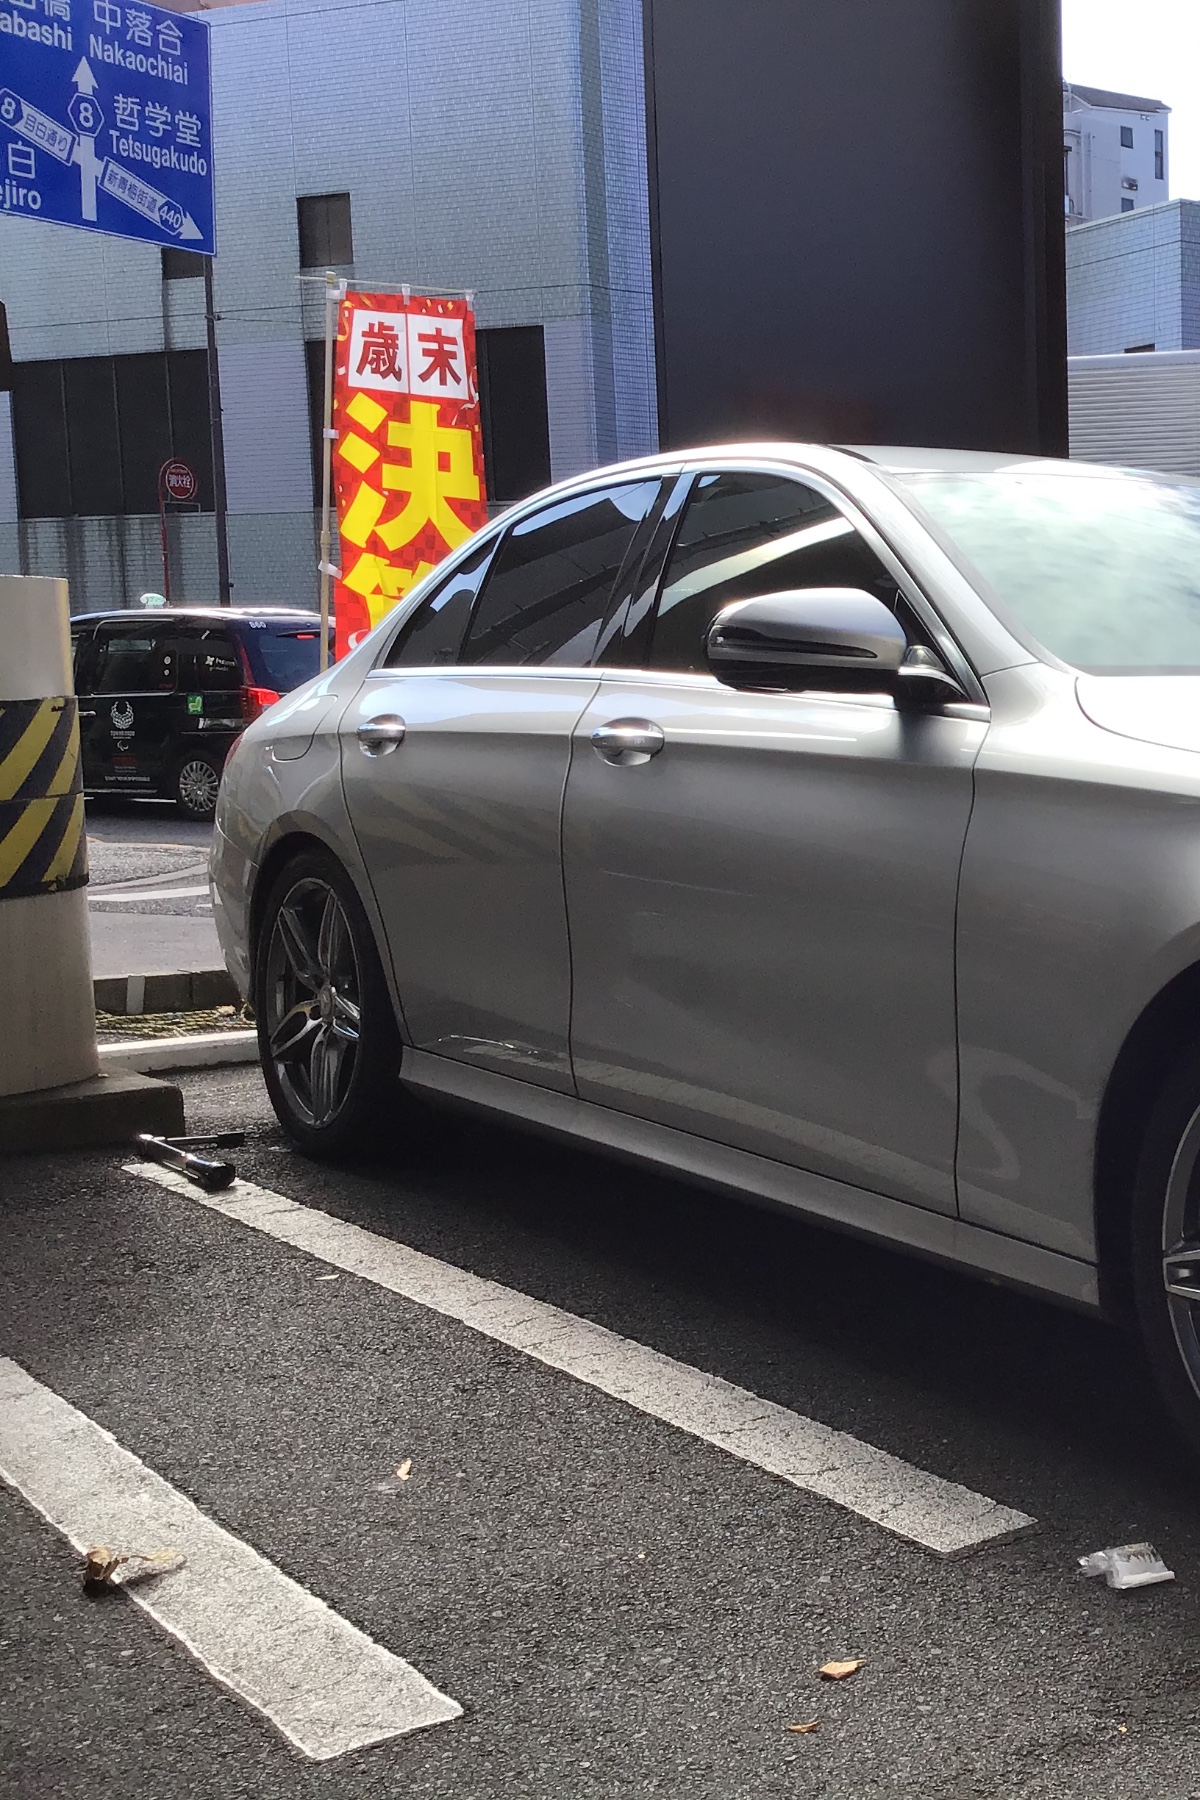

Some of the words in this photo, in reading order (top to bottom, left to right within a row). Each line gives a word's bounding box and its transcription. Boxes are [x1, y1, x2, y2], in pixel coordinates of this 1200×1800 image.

[93, 0, 184, 56] 中落合
[89, 34, 189, 86] Nakaochiai
[1, 97, 16, 119] 8
[24, 113, 68, 152] 目白通り
[78, 102, 94, 128] 8
[113, 93, 202, 148] 哲学堂
[109, 130, 208, 176] Tetsugakudo
[159, 205, 182, 229] 440
[356, 320, 462, 387] 歳末
